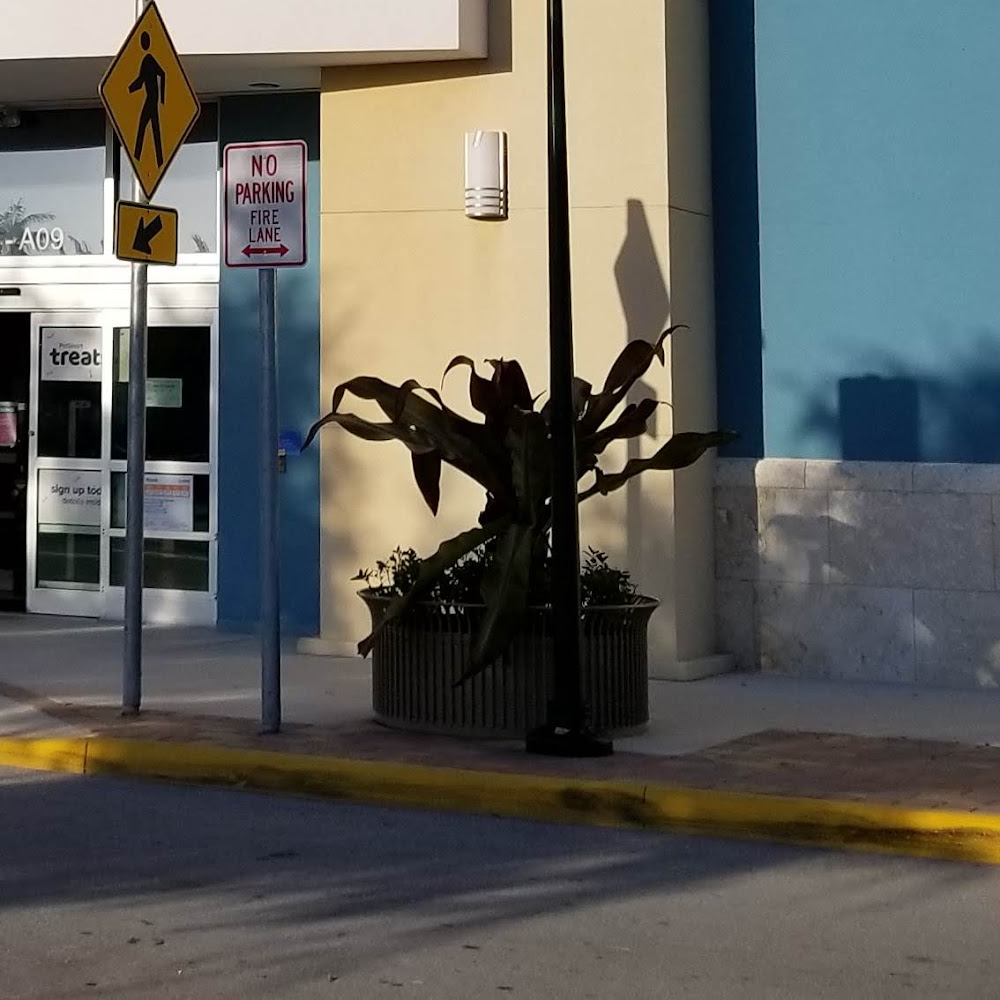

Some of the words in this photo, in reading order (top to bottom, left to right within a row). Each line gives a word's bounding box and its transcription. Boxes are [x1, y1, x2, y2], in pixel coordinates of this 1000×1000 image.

[251, 154, 278, 177] NO
[235, 180, 295, 205] PARKING
[250, 209, 279, 225] FIRE
[18, 227, 64, 250] A09
[249, 227, 281, 243] LANE
[51, 484, 70, 496] sign
[72, 486, 85, 496] up
